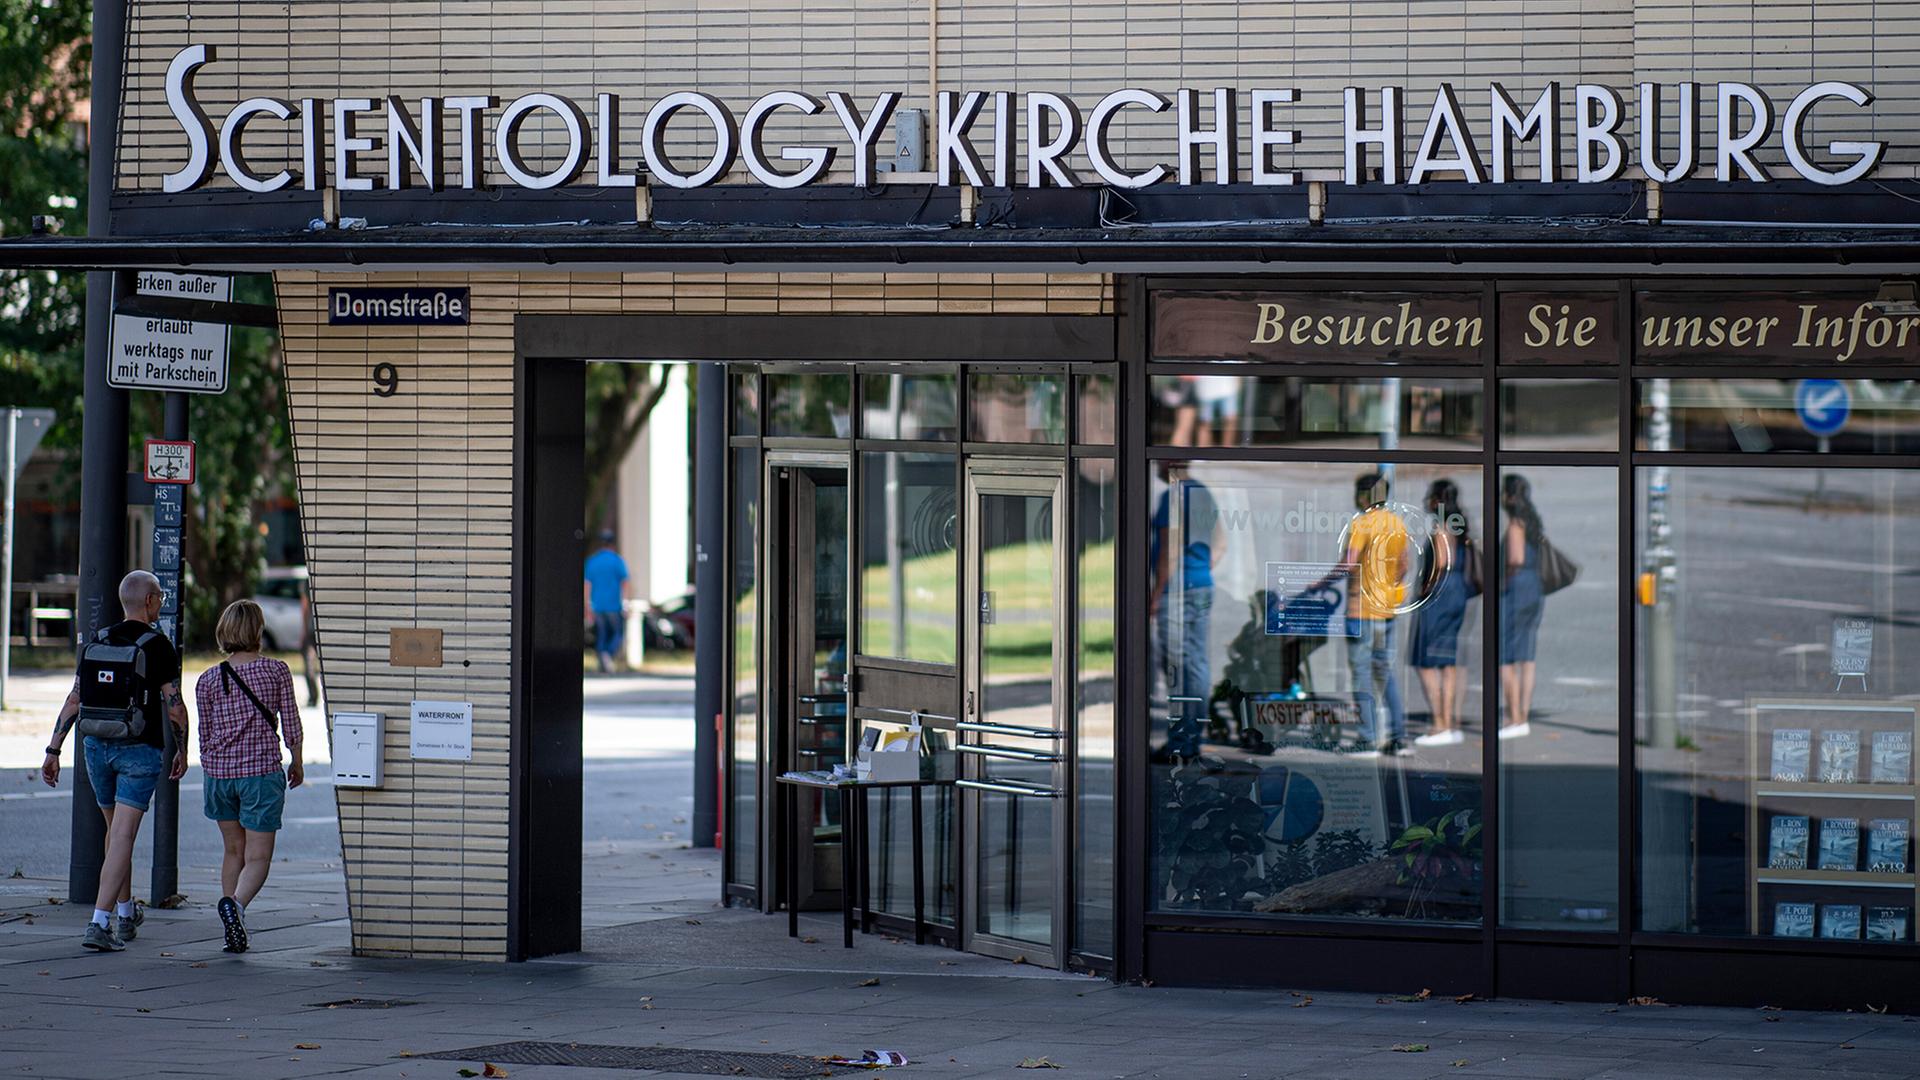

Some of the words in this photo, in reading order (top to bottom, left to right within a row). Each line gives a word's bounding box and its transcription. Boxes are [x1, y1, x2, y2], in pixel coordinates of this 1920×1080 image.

[938, 88, 1301, 188] KIRCHE
[1343, 81, 1889, 186] HAMBURG
[137, 274, 172, 291] arken
[179, 277, 217, 293] außer
[335, 292, 462, 319] Domstraße
[146, 319, 193, 335] erlaubt
[1250, 302, 1484, 347] Besuchen
[1524, 304, 1597, 347] Sie
[1641, 315, 1779, 347] unser
[124, 342, 184, 363] werktags
[191, 348, 213, 361] nur
[118, 362, 139, 378] mit
[145, 363, 217, 383] Parkschein
[373, 362, 398, 397] 9
[155, 489, 168, 500] HS
[154, 532, 160, 542] S
[418, 711, 464, 719] WATERFRONT
